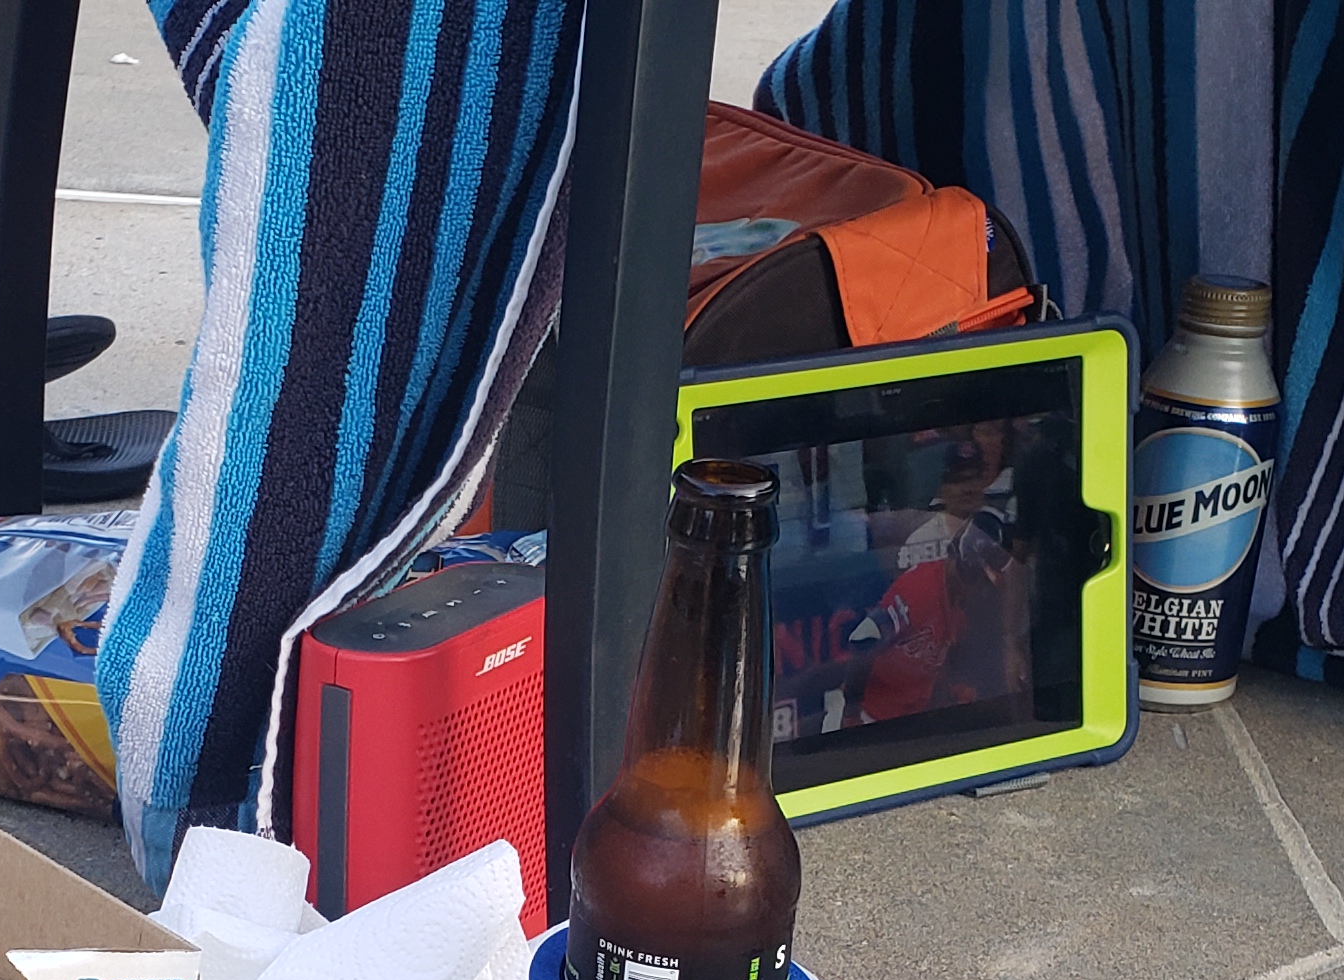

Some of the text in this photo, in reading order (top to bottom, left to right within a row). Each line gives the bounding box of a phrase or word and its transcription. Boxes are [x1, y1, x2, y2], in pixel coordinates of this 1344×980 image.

[1133, 467, 1272, 535] LUE MOON
[1133, 590, 1225, 618] ELGIAN
[475, 636, 533, 677] BOSE
[599, 938, 679, 968] DRINK FRESH
